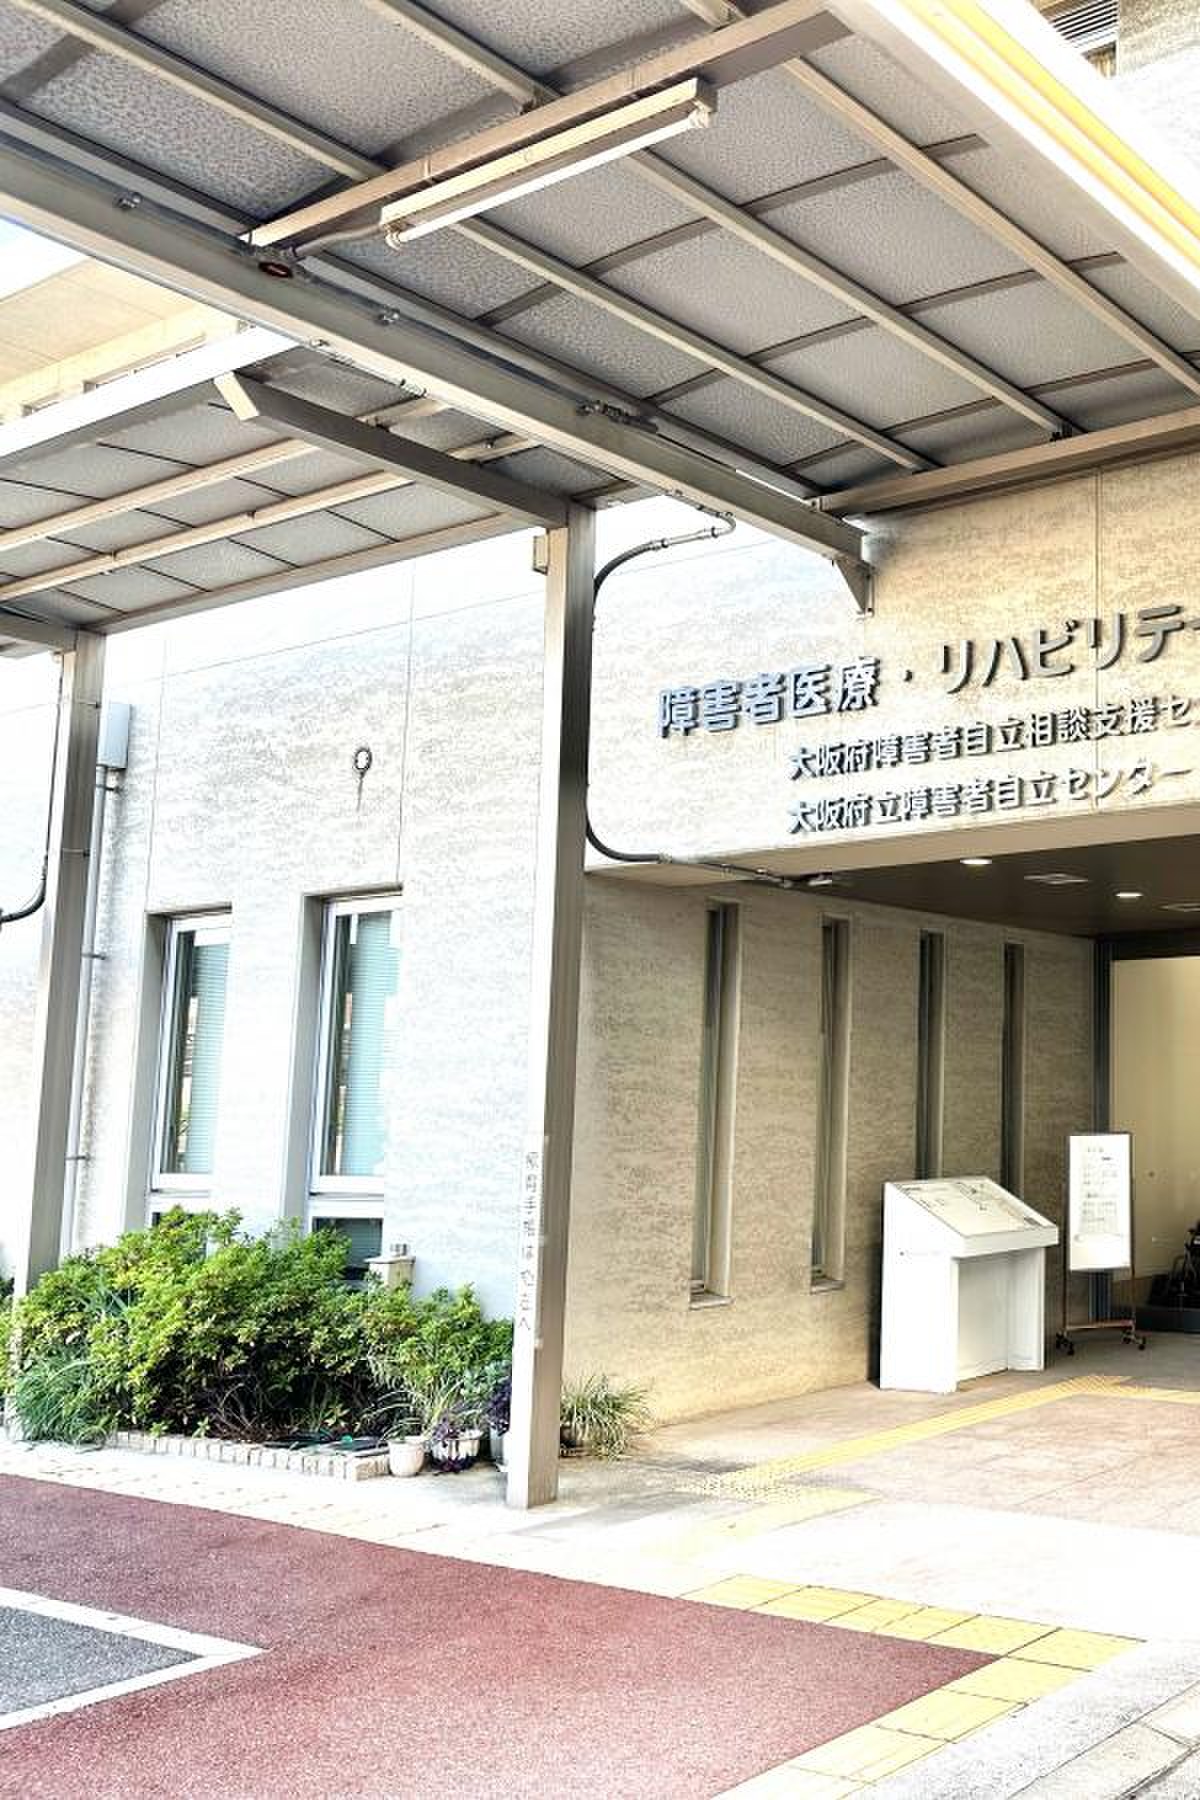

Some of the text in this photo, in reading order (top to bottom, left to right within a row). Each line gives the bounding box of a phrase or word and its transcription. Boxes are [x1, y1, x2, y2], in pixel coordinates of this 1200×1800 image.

[789, 760, 1192, 834] 大阪府立障害者自立センター
